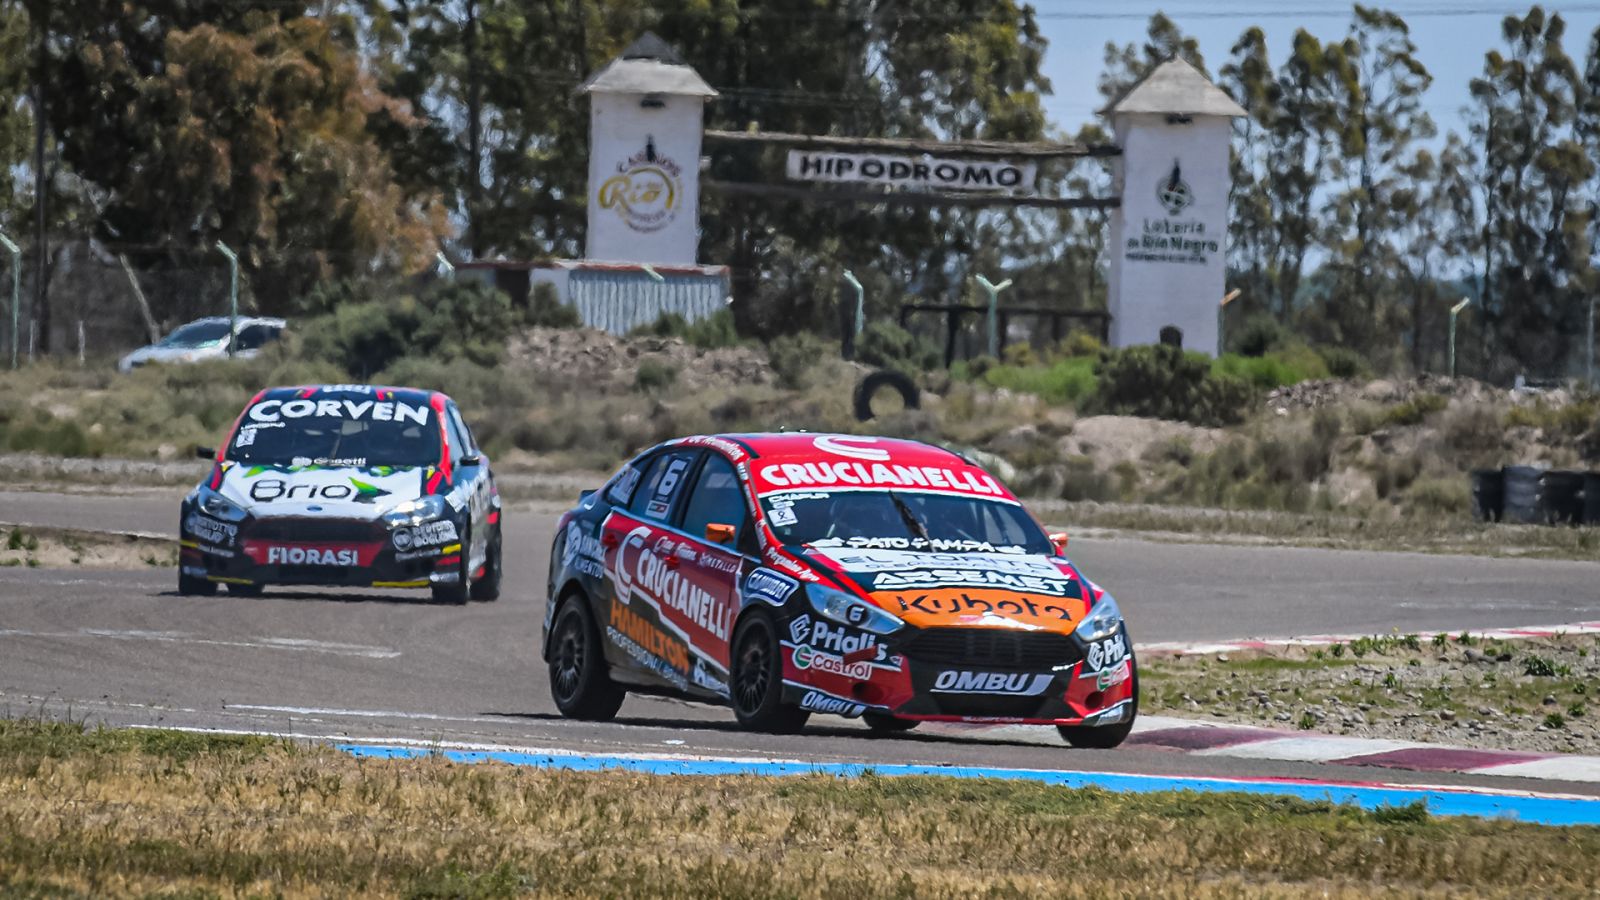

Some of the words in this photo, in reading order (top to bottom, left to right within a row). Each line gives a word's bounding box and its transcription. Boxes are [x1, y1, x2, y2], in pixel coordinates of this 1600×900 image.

[802, 156, 1020, 186] HIPODROMO
[249, 399, 429, 426] CORVEN
[250, 479, 352, 502] Brio
[658, 459, 688, 497] 6
[760, 462, 1003, 495] CRUCIANELLI
[268, 546, 359, 567] FIORASI
[873, 569, 1070, 592] ARSEMET
[637, 548, 732, 642] CRUCIANELLI
[896, 594, 1073, 622] Kubota
[849, 606, 865, 621] 6
[609, 598, 690, 675] HAMILTON
[812, 654, 871, 679] Castrol
[934, 670, 1019, 692] OMBU
[801, 691, 854, 714] OMBU
